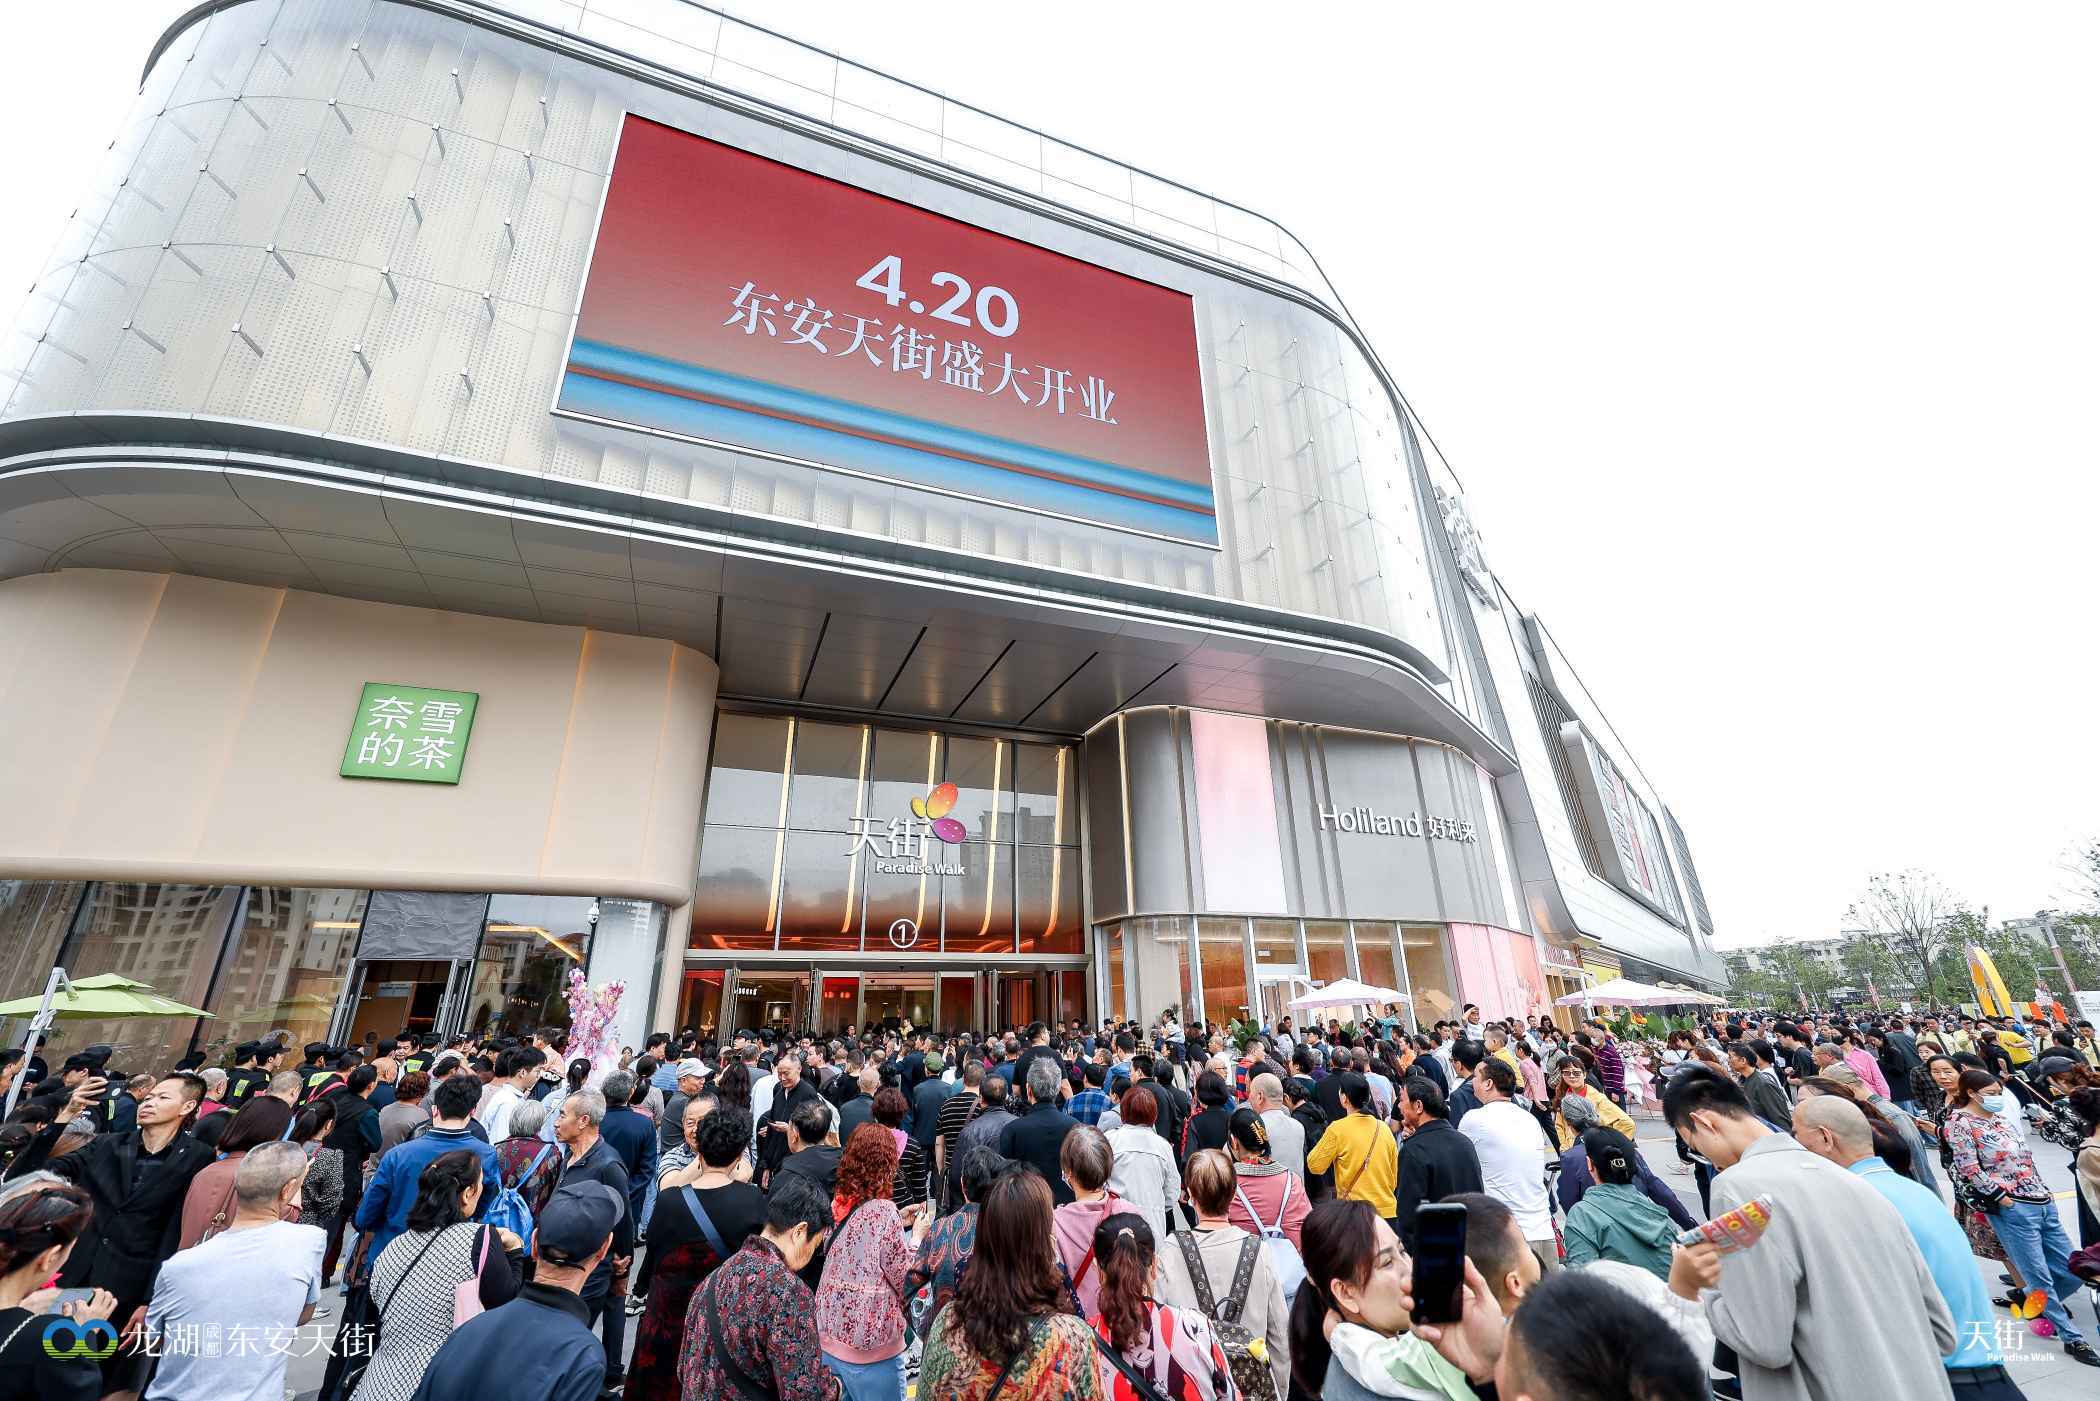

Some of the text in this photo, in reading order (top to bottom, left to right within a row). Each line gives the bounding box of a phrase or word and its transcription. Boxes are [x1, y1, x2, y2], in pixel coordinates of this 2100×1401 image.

[855, 255, 1020, 338] 4.20
[722, 281, 1119, 425] 东安天街盛大开业
[367, 695, 464, 735] 奈雪
[357, 731, 456, 770] 的茶
[843, 816, 930, 860] 天街
[1318, 802, 1477, 843] Holiland 好利来
[875, 861, 966, 876] Paradise Walk
